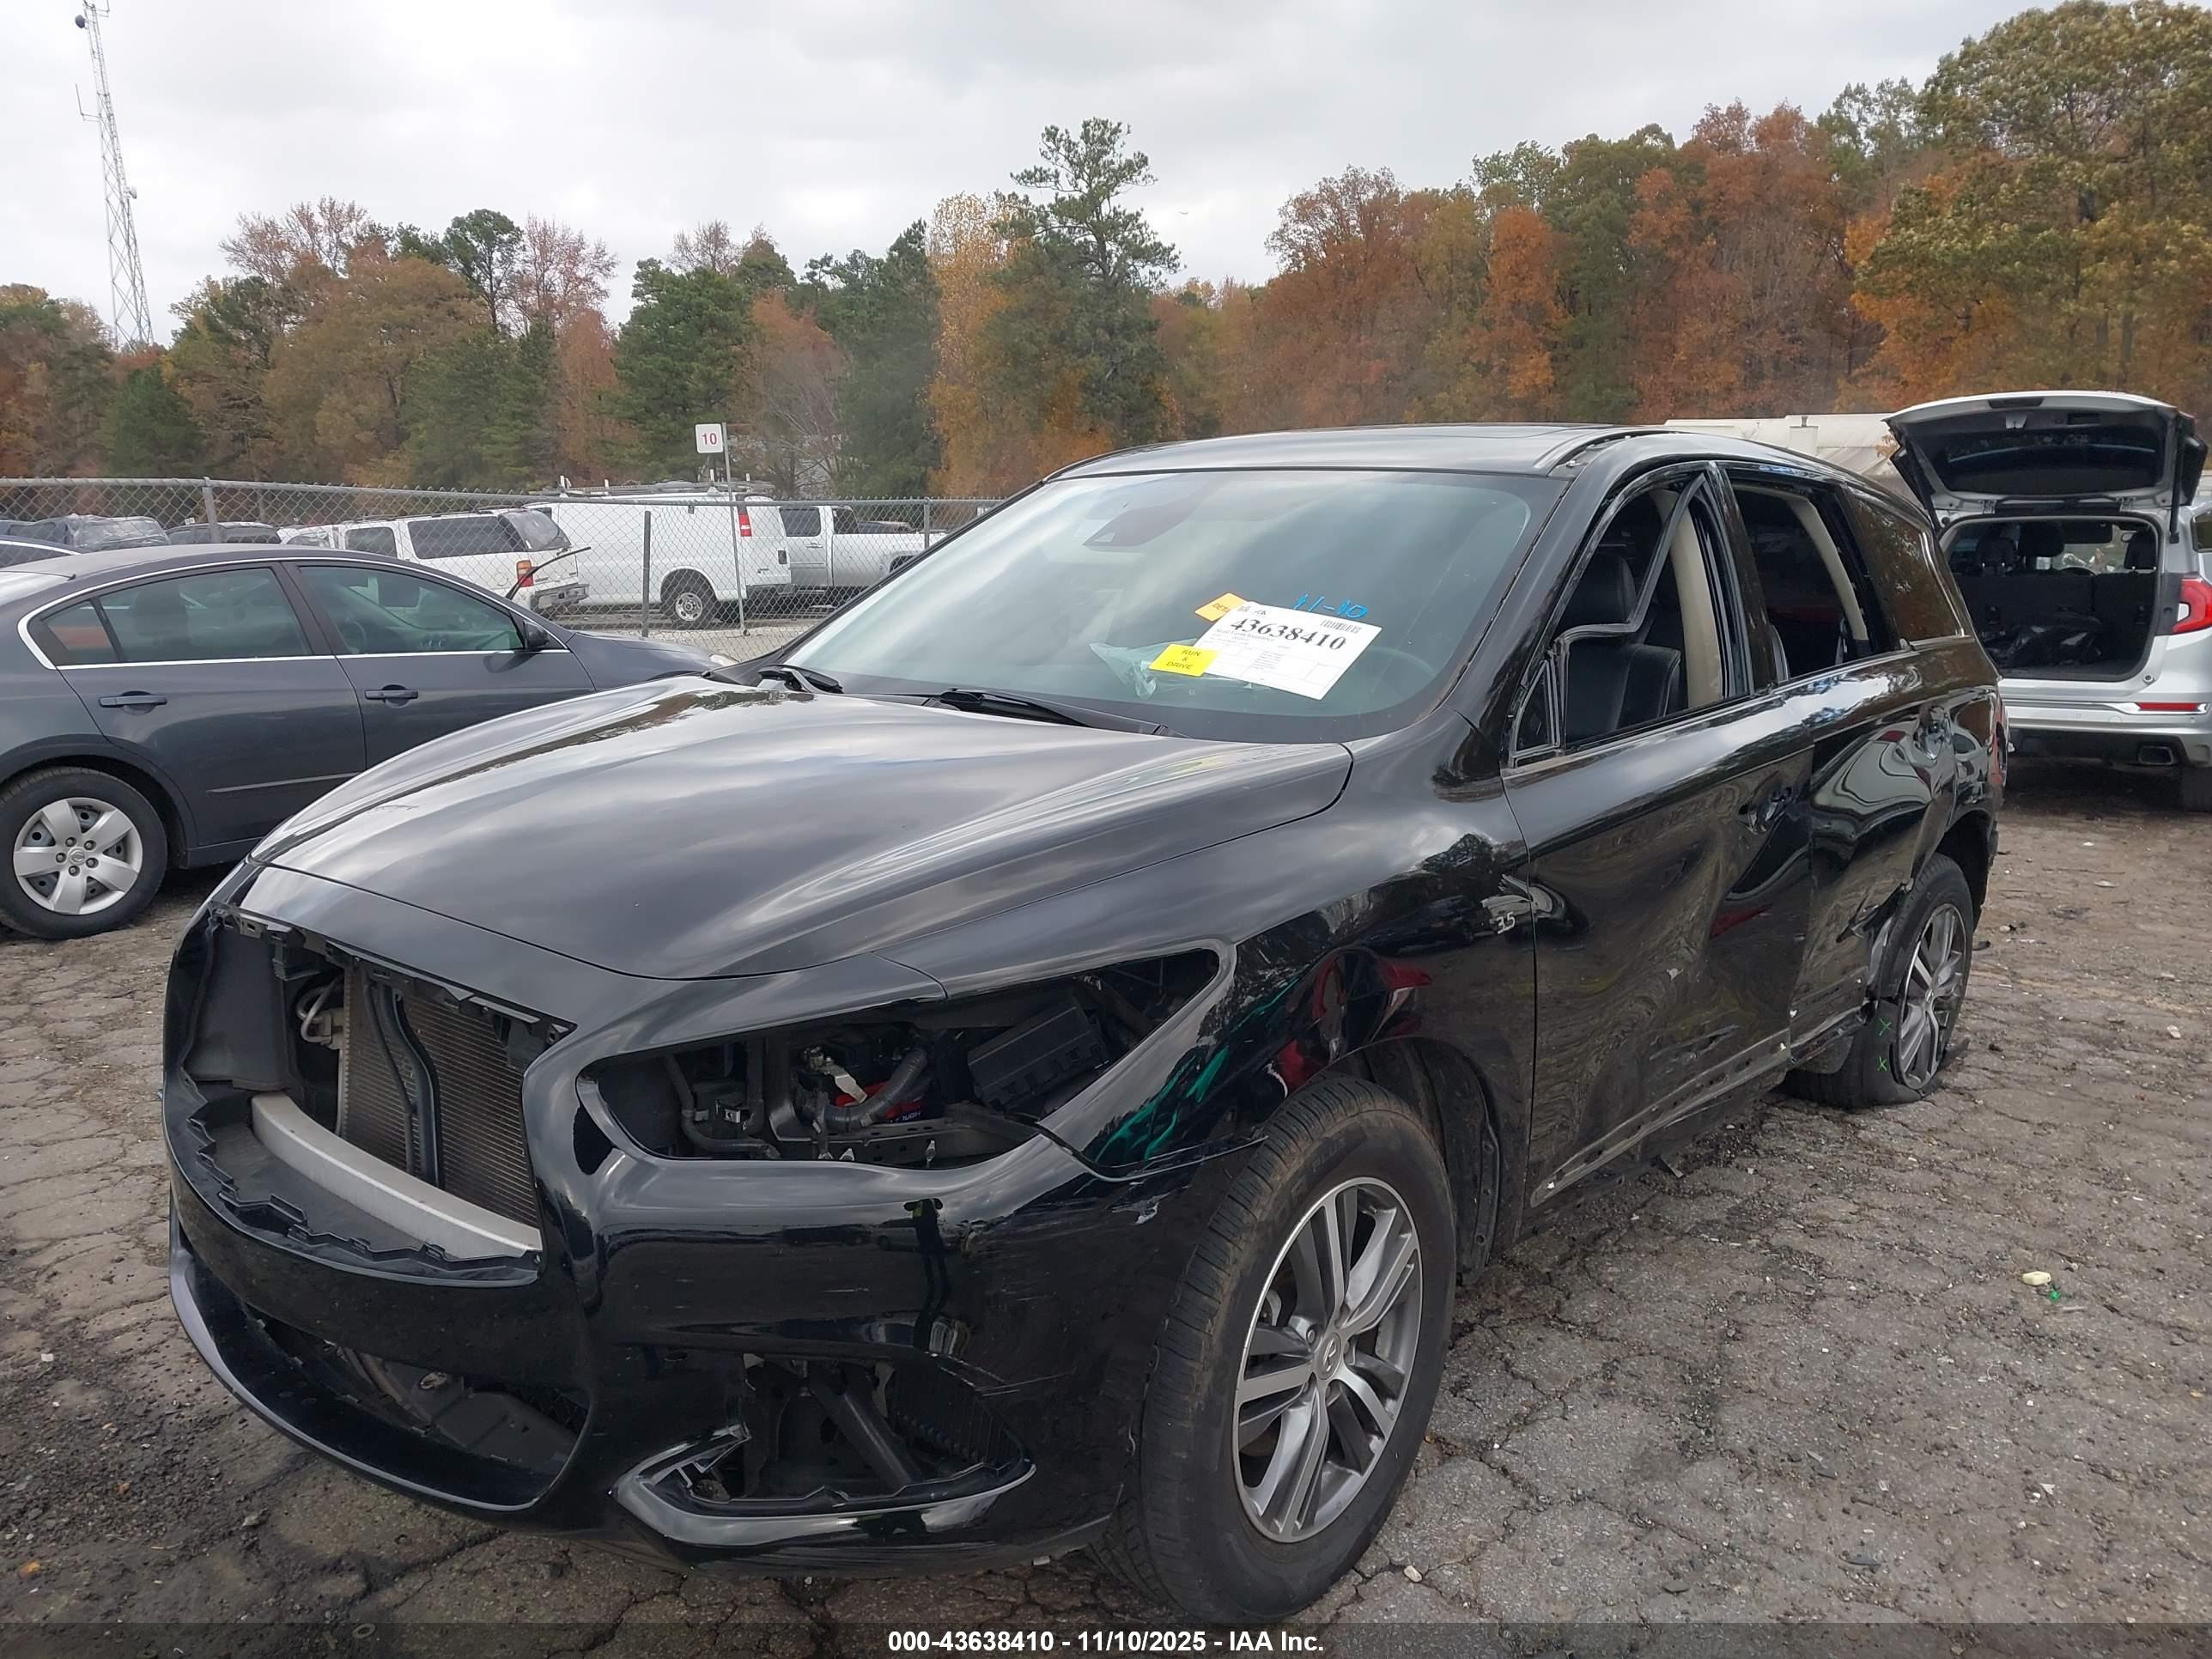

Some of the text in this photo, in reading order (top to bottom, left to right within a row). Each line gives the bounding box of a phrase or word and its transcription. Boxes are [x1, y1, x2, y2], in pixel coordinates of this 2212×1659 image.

[702, 433, 717, 445] 10
[1231, 618, 1346, 650] 43638410
[1166, 661, 1193, 670] DRIVE
